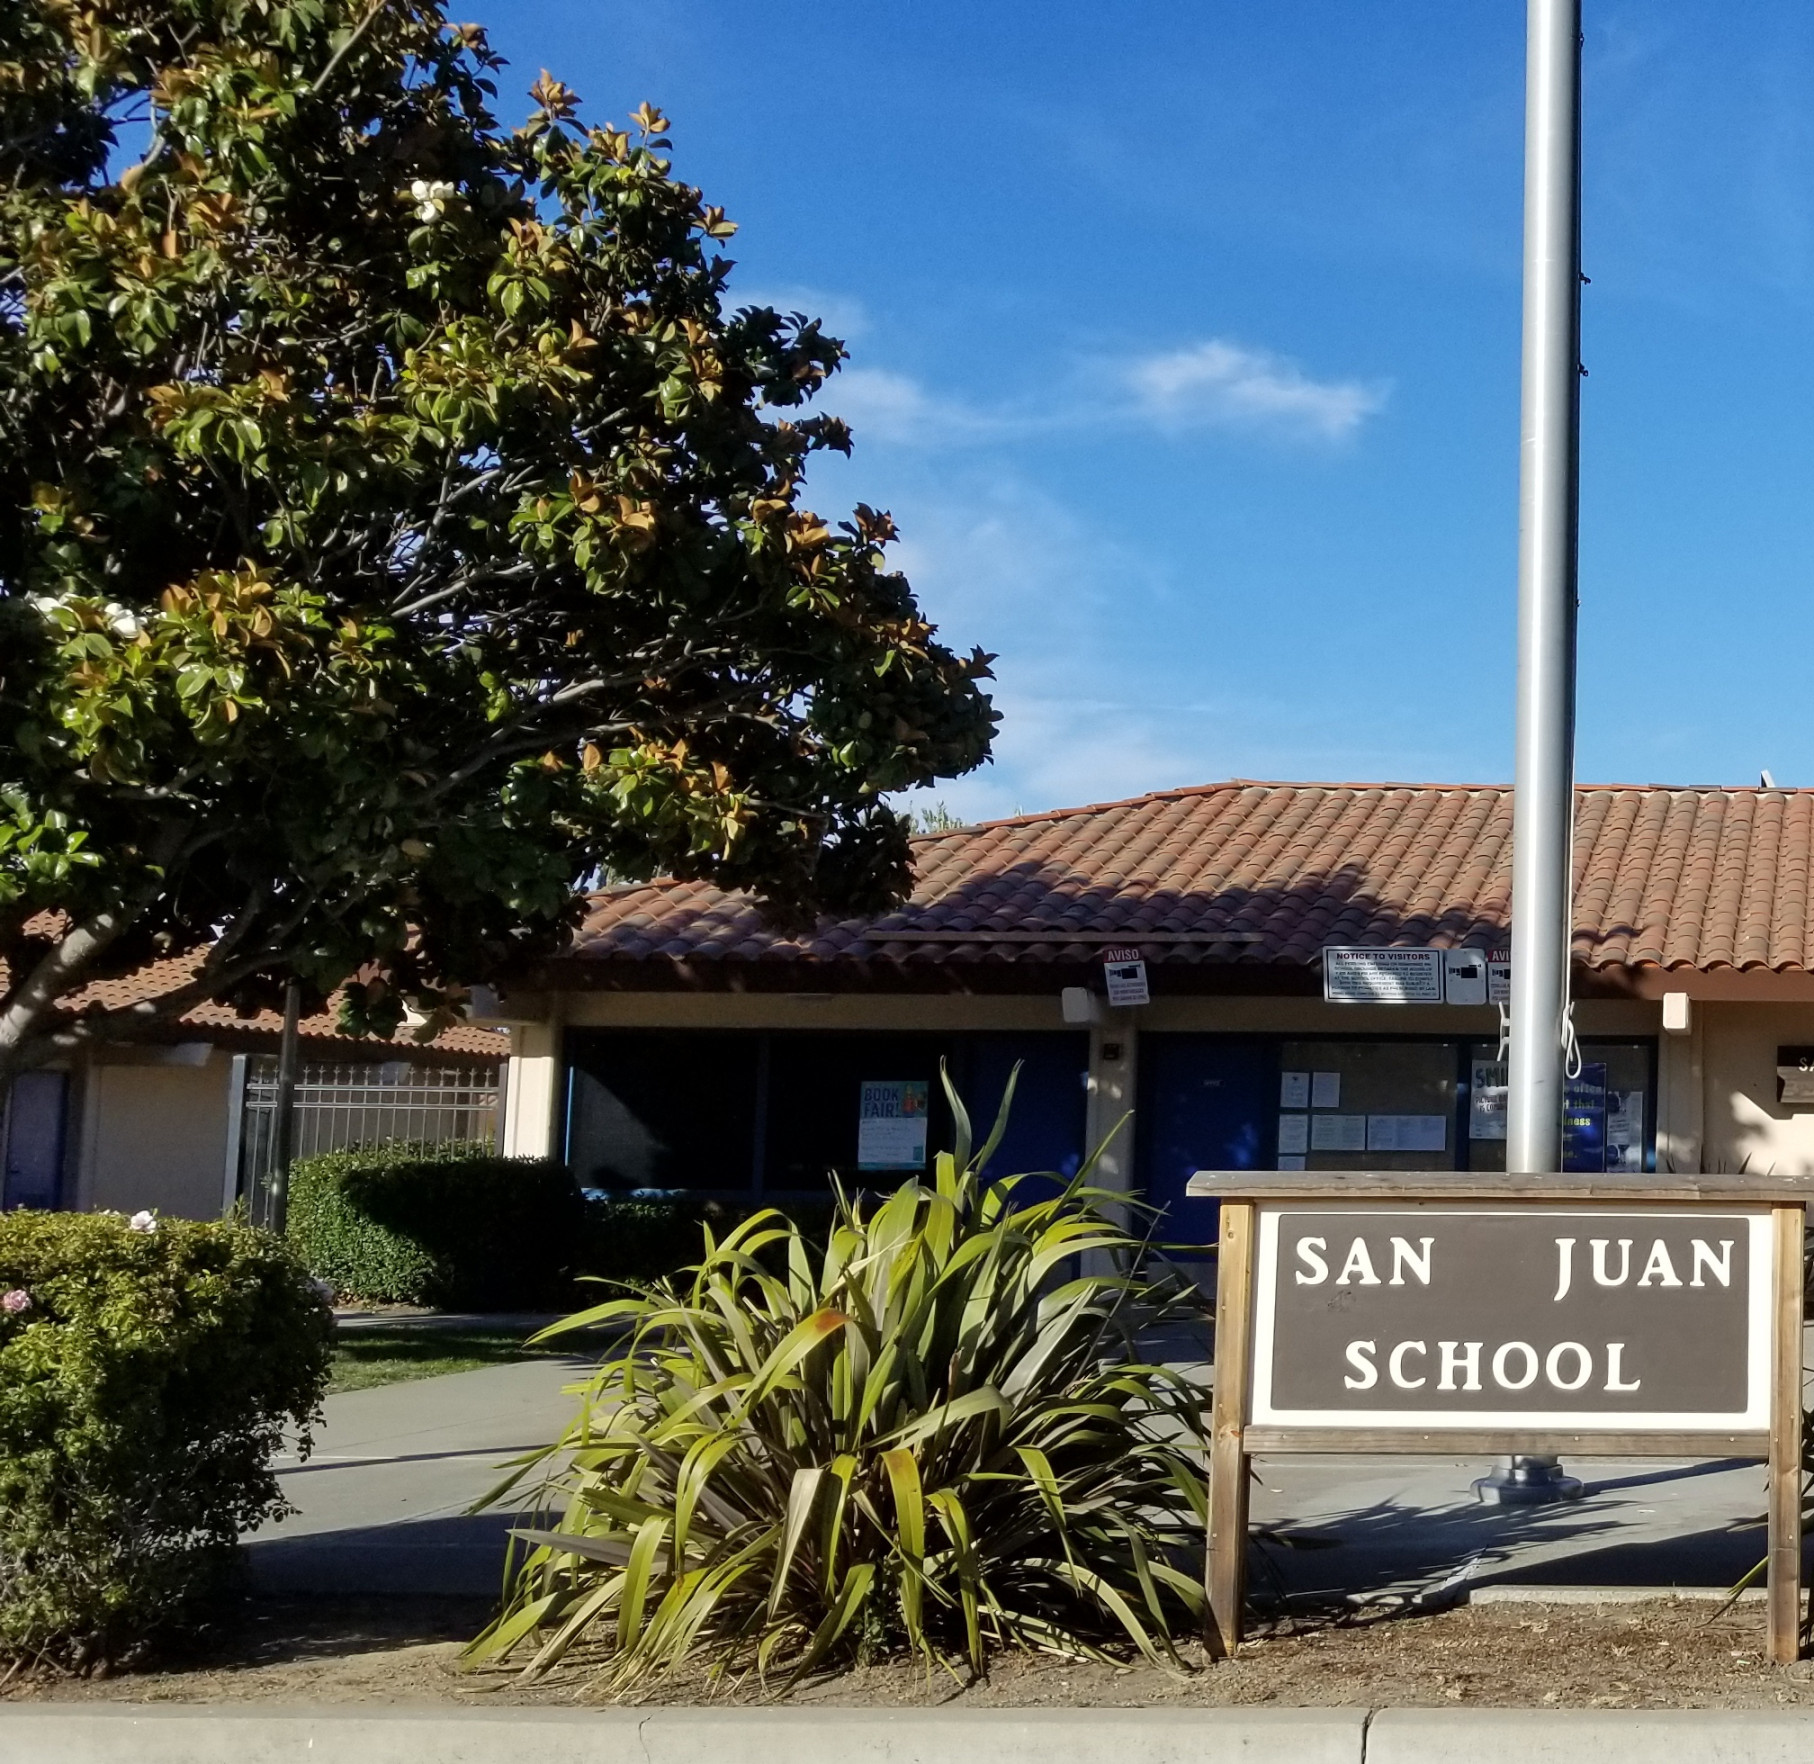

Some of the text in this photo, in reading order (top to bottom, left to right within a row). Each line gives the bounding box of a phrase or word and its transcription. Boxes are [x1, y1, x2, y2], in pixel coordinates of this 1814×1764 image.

[1108, 949, 1139, 961] AVISO
[1492, 950, 1510, 961] AVI
[1476, 1067, 1508, 1088] SMI
[864, 1087, 899, 1101] BOOK
[864, 1102, 900, 1118] FAIR!
[1294, 1236, 1735, 1301] SAN JUAN
[1343, 1339, 1641, 1391] SCHOOL
